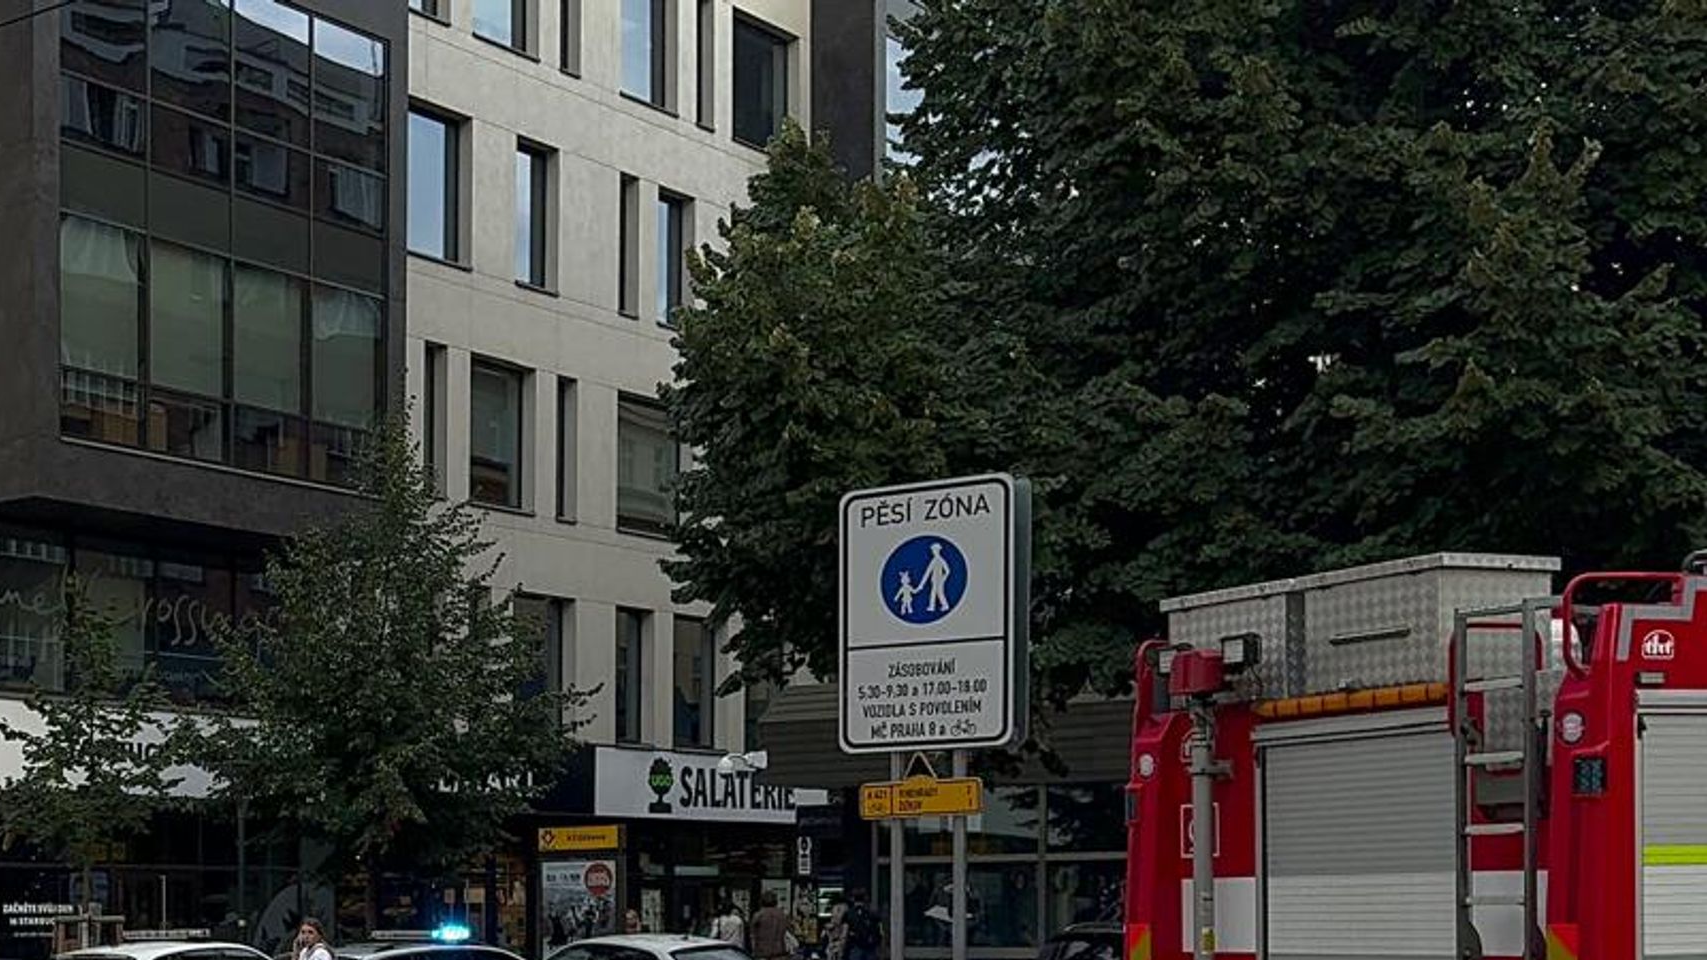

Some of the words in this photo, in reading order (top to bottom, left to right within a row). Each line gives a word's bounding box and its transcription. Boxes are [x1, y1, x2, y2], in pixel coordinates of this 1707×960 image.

[924, 493, 991, 520] ZÓNA
[888, 658, 956, 678] ZÁSOBOVÁNÍ
[912, 686, 919, 696] a
[862, 704, 905, 718] VOZIDLA
[909, 703, 917, 716] S
[920, 697, 982, 716] POVOLENÍM
[871, 722, 888, 739] MČ
[890, 722, 925, 738] PRAHA
[928, 721, 936, 736] 8
[679, 766, 795, 810] SALATERIE
